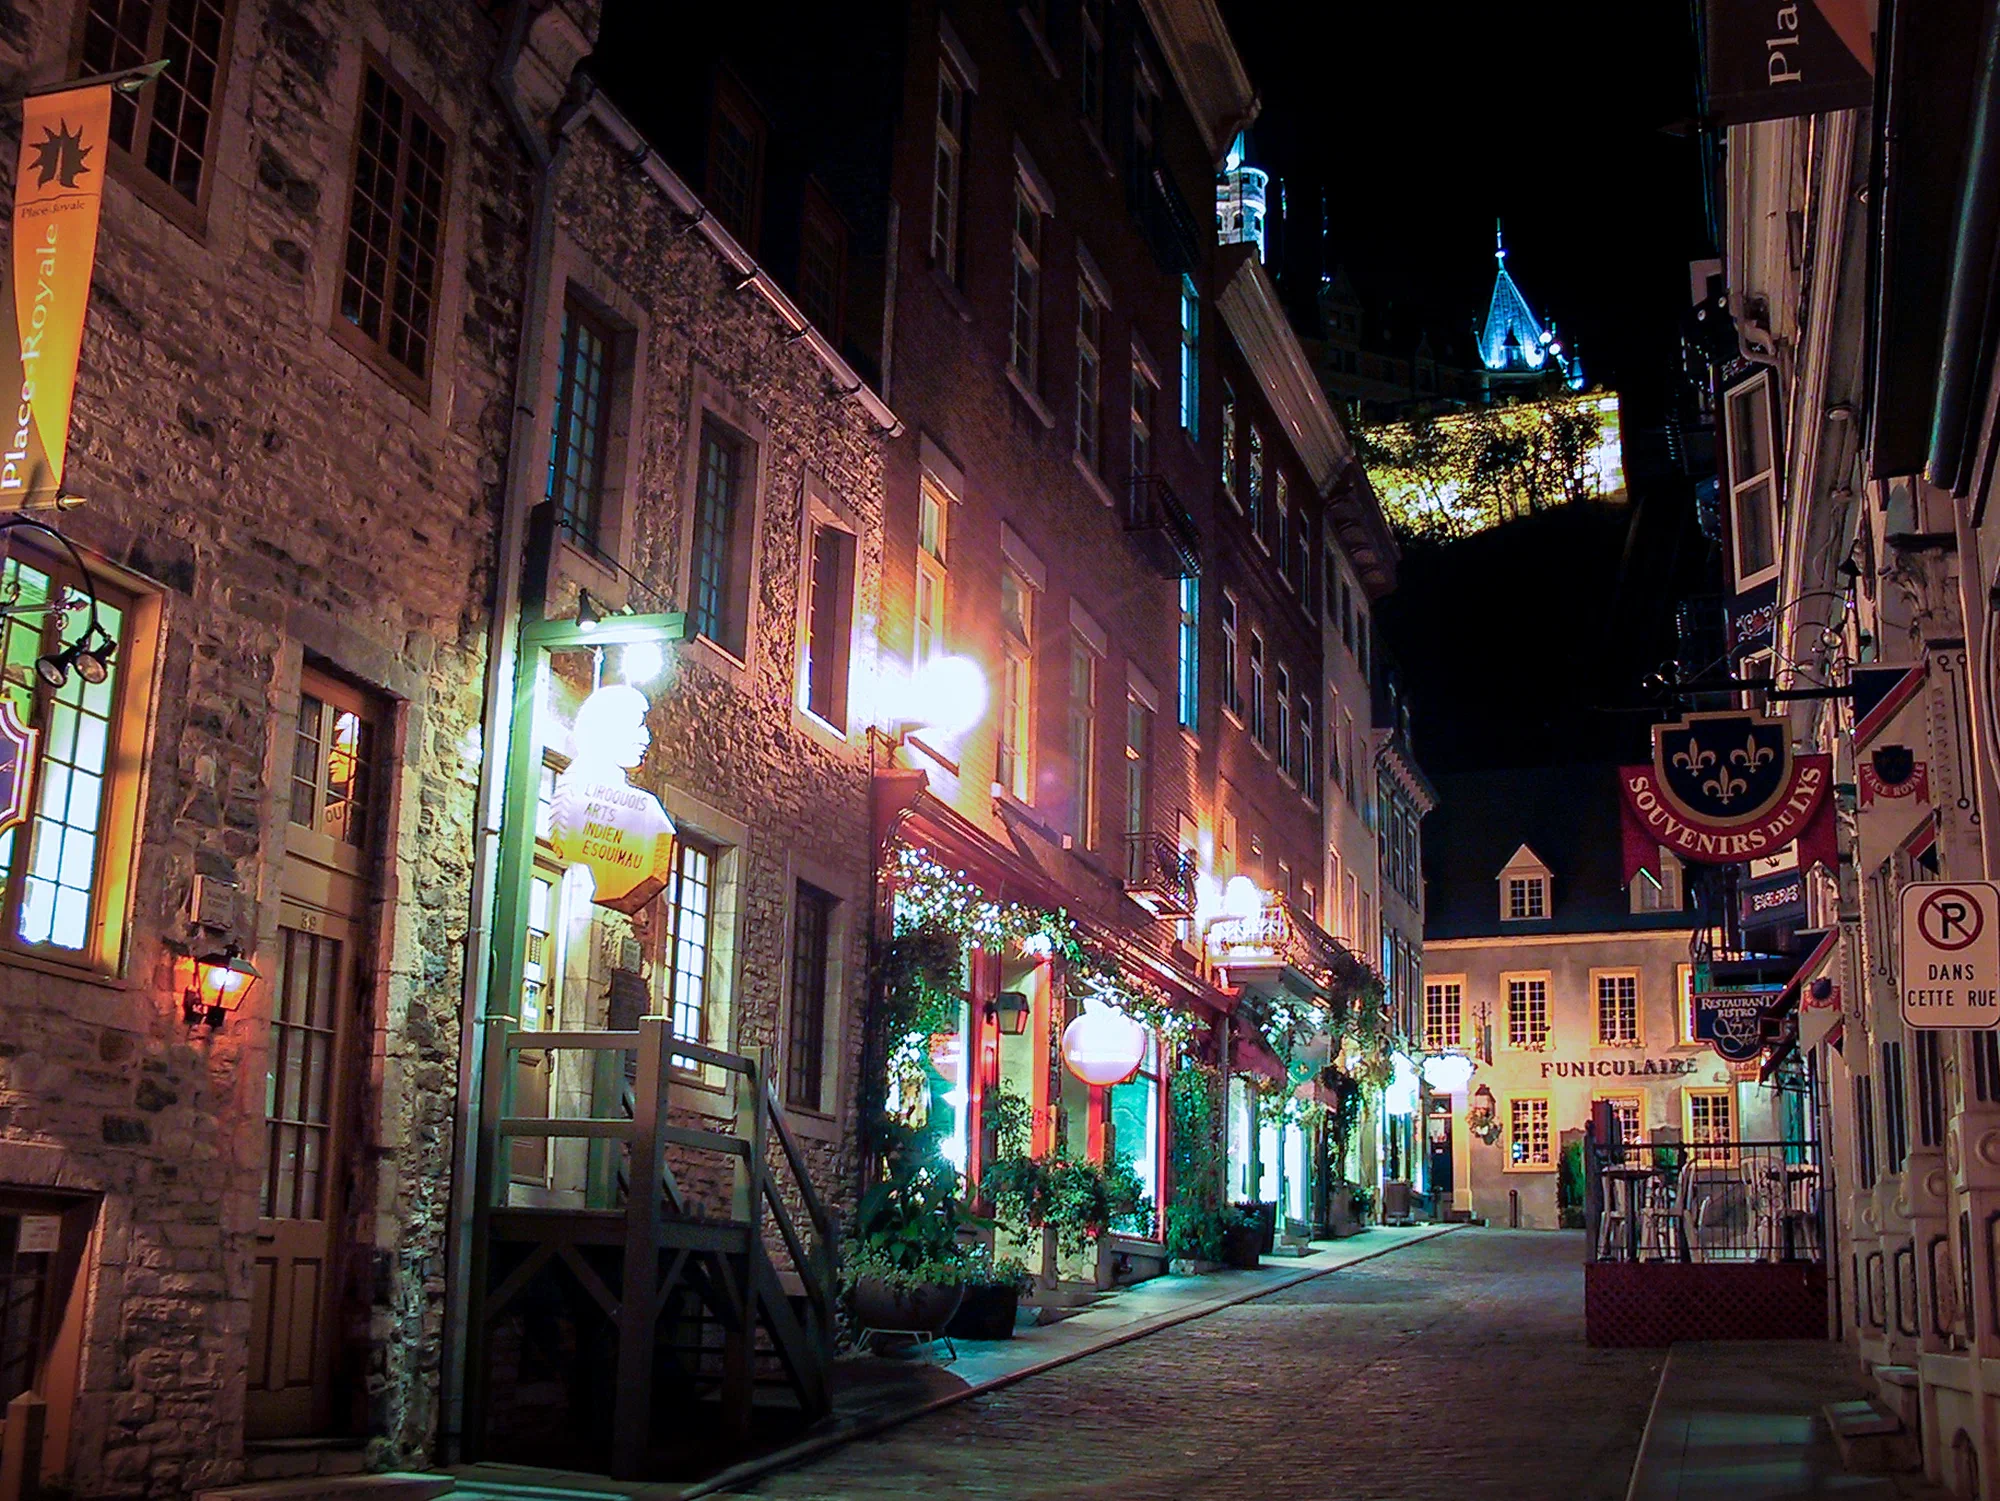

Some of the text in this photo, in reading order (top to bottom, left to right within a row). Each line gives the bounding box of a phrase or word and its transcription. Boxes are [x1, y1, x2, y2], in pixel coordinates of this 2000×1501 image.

[1766, 0, 1801, 86] Pla
[583, 801, 616, 823] ARTS
[1629, 767, 1822, 855] SOUVENIRS DU LYS
[582, 821, 624, 844] INDIEN
[581, 839, 643, 869] ESQUIMAU
[1928, 963, 1974, 981] DANS
[1701, 995, 1774, 1010] RESTAURANT
[1908, 989, 1997, 1007] CETTE RUE
[1718, 1007, 1757, 1018] BISTRO
[1540, 1058, 1698, 1079] FUNICULAIRE
